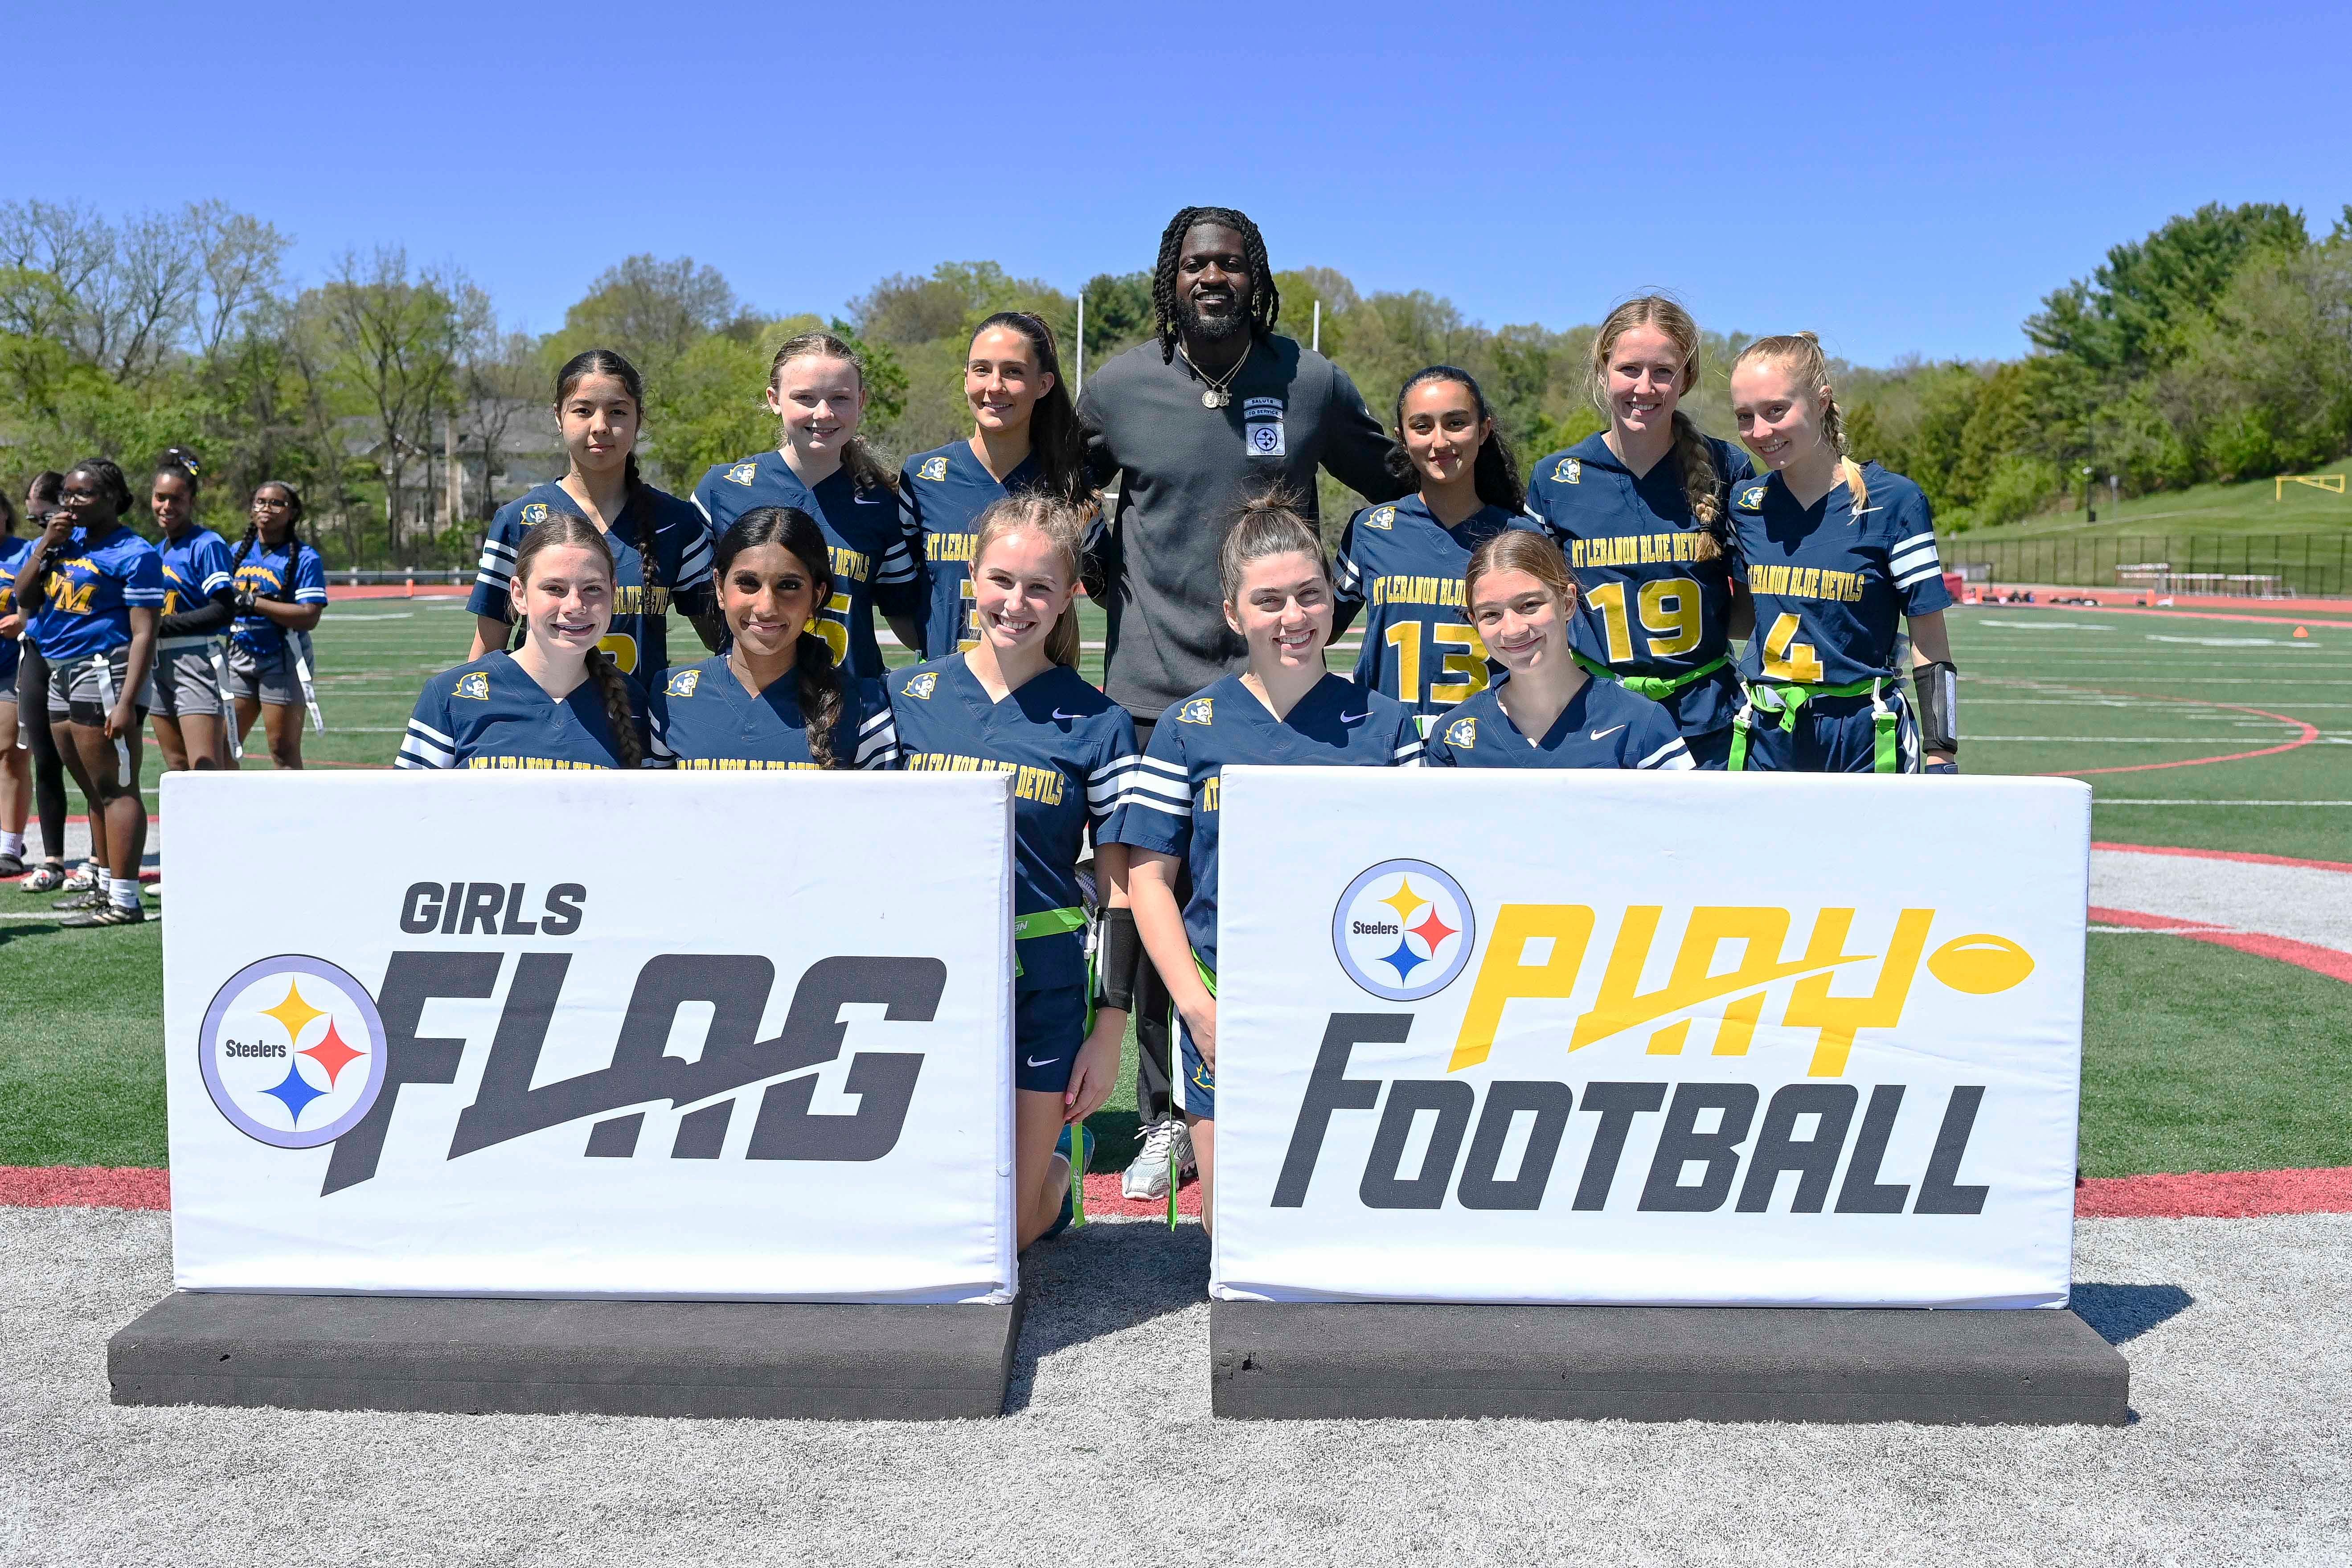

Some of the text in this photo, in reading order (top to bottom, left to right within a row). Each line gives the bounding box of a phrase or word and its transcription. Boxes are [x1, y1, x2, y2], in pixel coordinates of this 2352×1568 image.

[834, 547, 870, 582] DEVILS
[926, 533, 979, 561] MT LEBAN
[1572, 532, 1698, 568] MT LEBANON BLUE DEV
[612, 585, 642, 614] BLUE
[1373, 576, 1385, 606] MT
[1386, 575, 1439, 605] LEBANON
[1750, 565, 1791, 595] LEBANON
[1788, 566, 1820, 599] BLUE
[1819, 569, 1864, 602] DEVILS
[1585, 577, 1703, 663] 19
[1385, 620, 1490, 704] 13
[1760, 612, 1824, 684] 4
[1015, 765, 1064, 806] DEVILS
[400, 882, 586, 936] GIRLS
[1353, 921, 1398, 934] Steelers
[1447, 904, 1935, 1077] PLAY
[226, 1039, 286, 1058] Steelers
[312, 951, 947, 1197] FLAG
[1270, 1012, 1990, 1215] FOOTBALL
